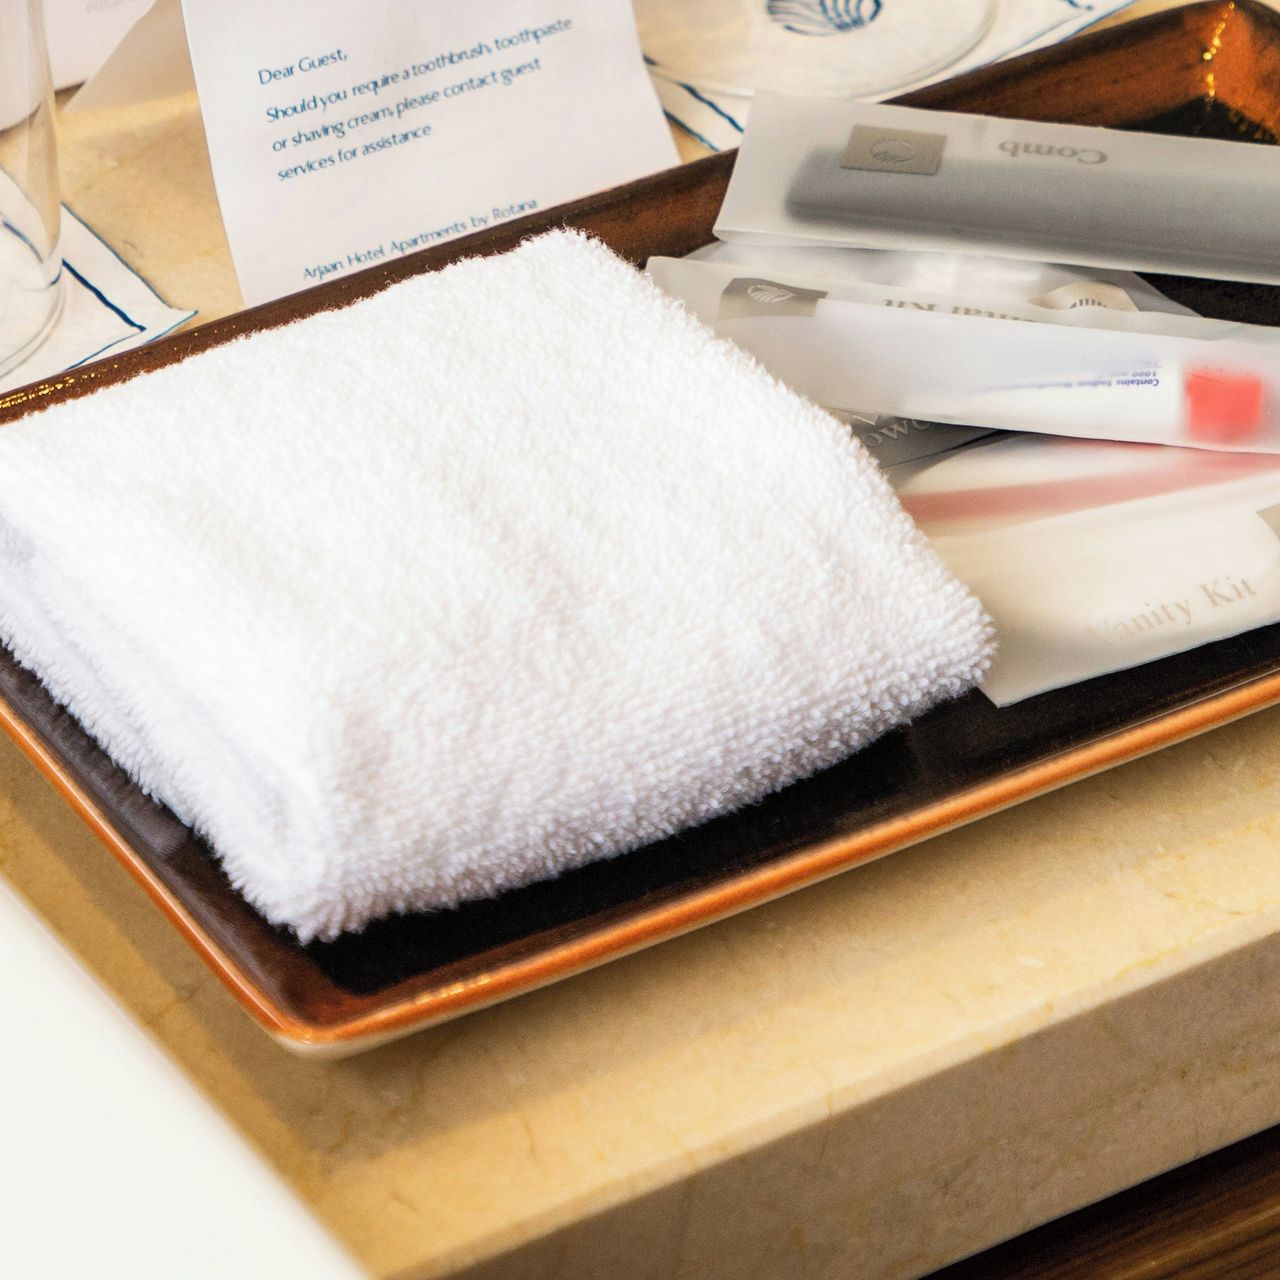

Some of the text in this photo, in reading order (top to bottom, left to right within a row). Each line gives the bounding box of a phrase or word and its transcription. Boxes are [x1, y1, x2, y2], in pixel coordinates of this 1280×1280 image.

[258, 48, 348, 85] Dear Guest,
[266, 18, 572, 123] Should you require a toothbrush, toothpaste
[272, 57, 541, 152] or shaving cream, please contact guest
[277, 124, 432, 182] services for assistance
[998, 141, 1108, 165] Comb
[303, 199, 538, 281] Arjaan Hotel Apartments by Rotana
[1116, 378, 1160, 387] Contains
[1086, 575, 1257, 646] Vanity Kit
